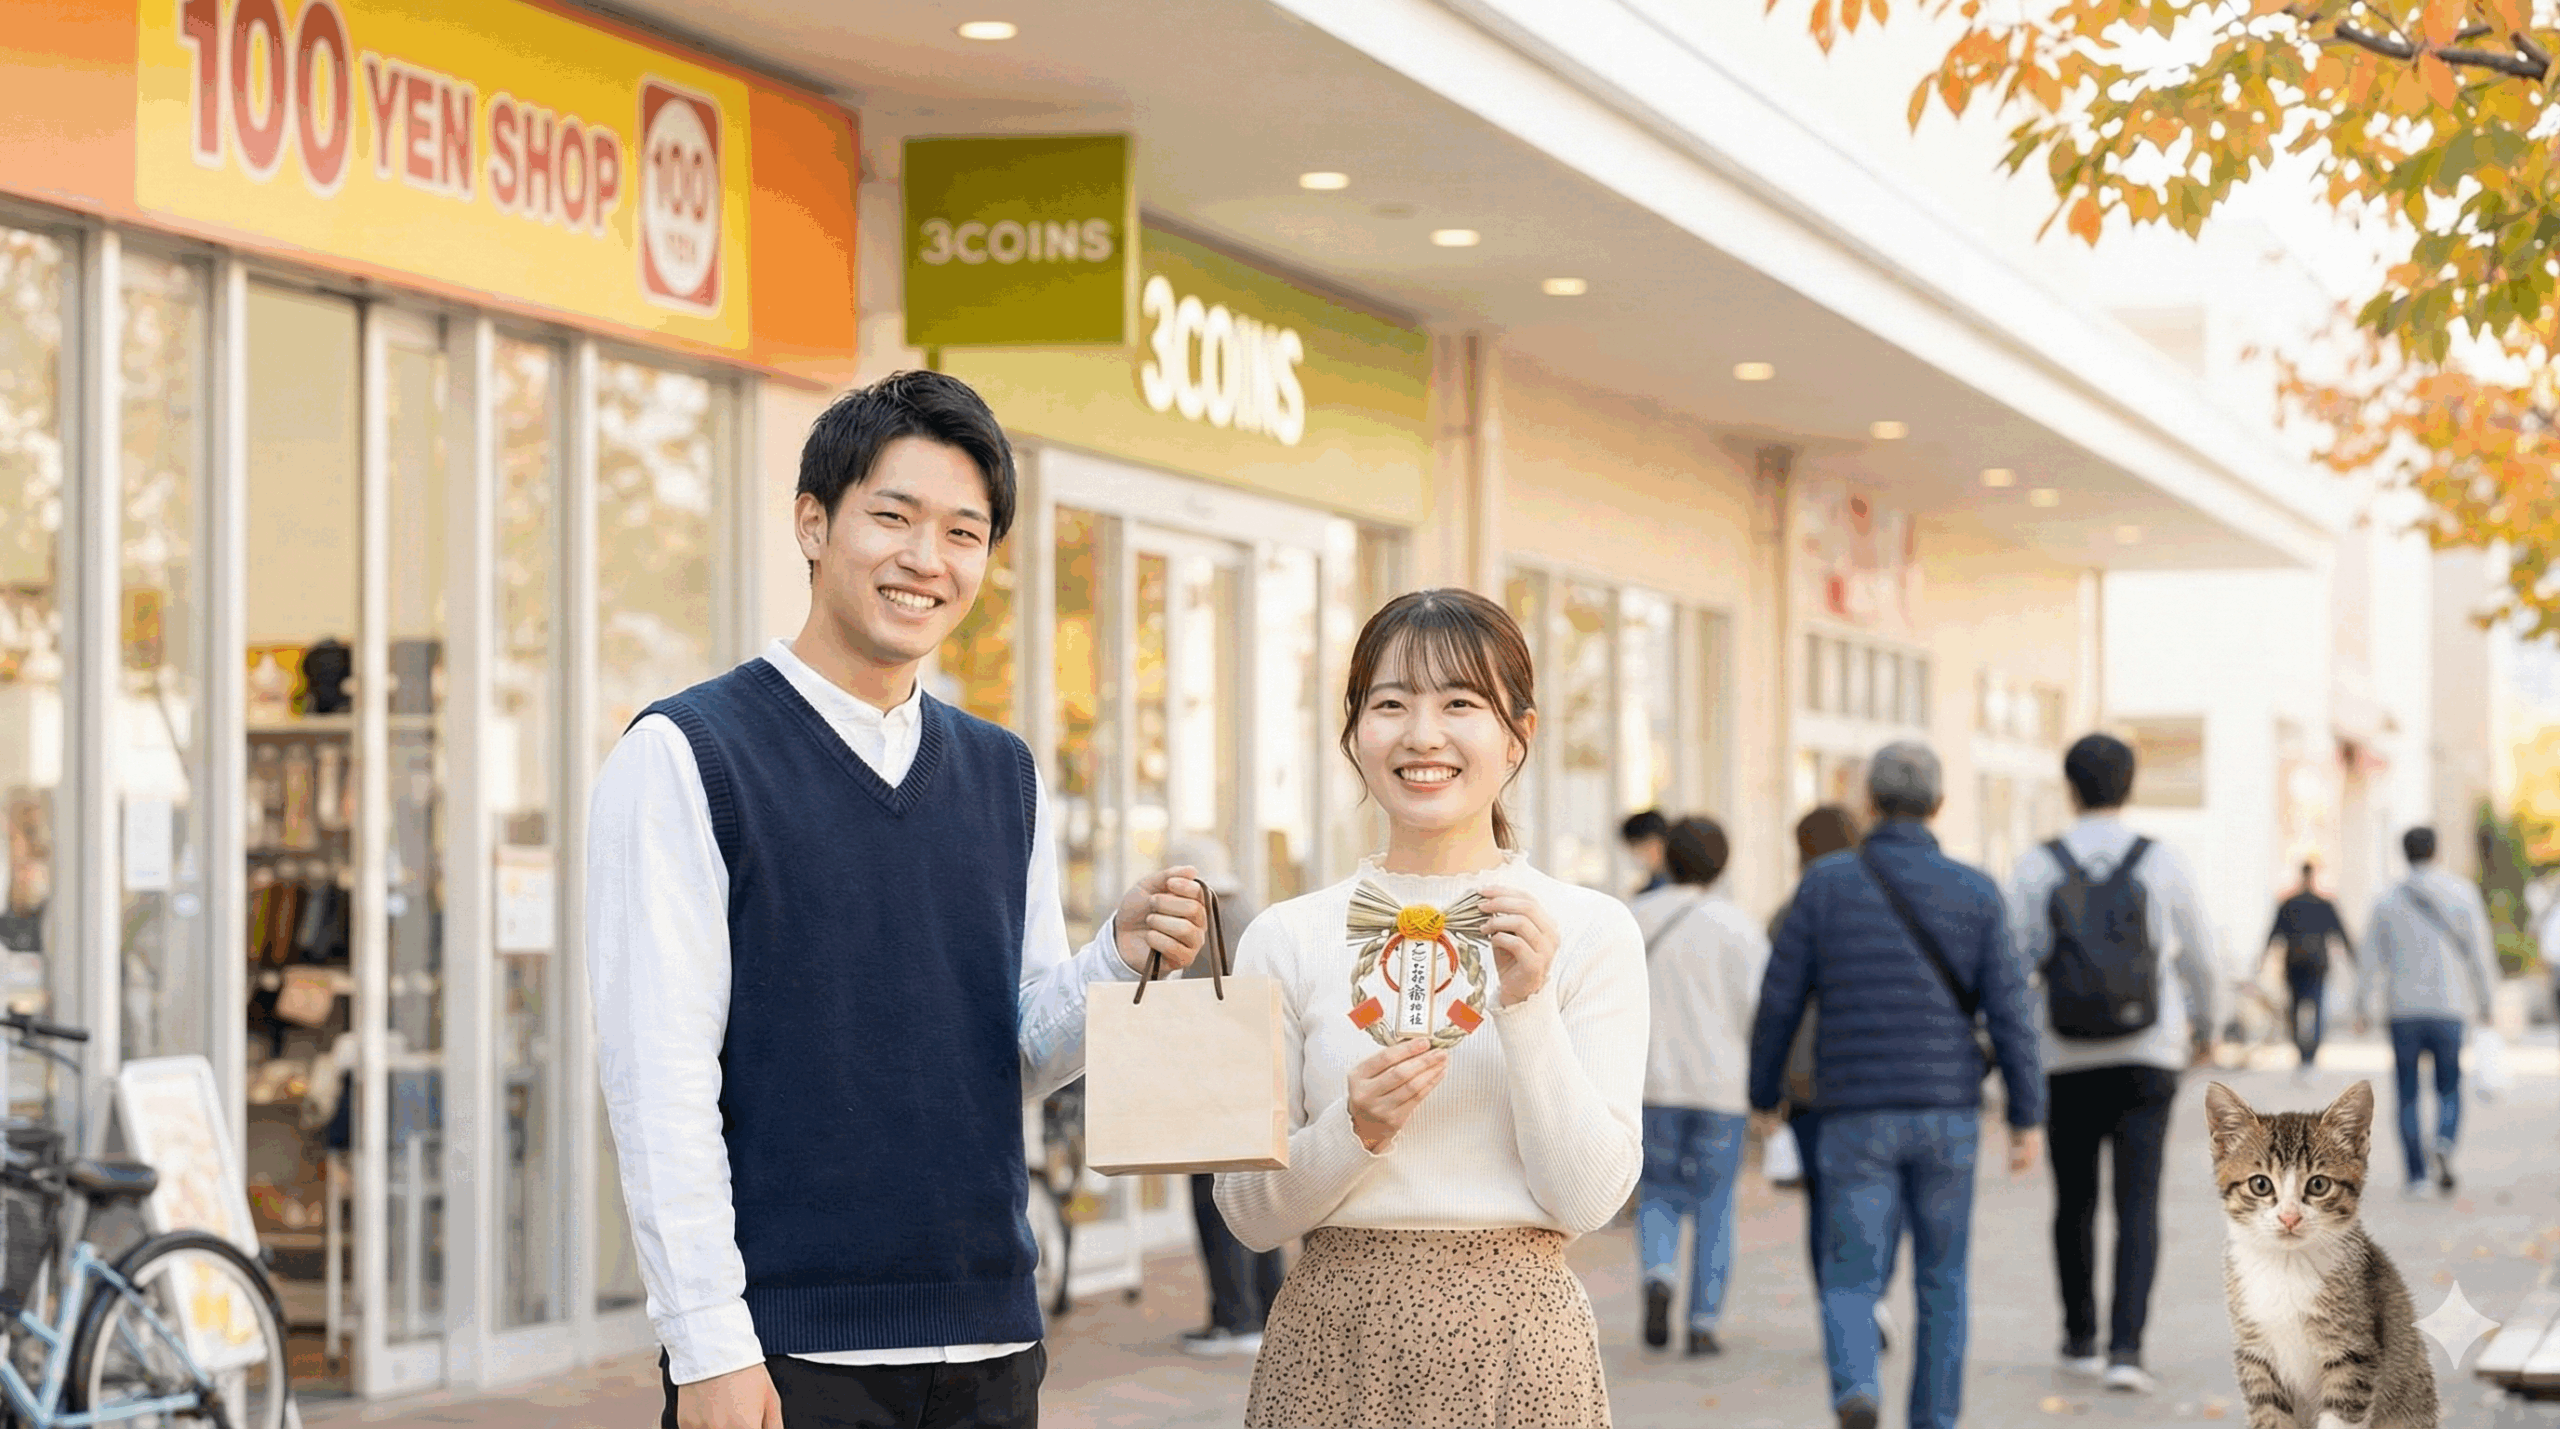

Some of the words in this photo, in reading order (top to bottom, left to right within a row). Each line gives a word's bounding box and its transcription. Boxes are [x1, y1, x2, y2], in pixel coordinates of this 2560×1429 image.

[182, 0, 350, 187] 100
[365, 59, 472, 192] YEN
[490, 100, 620, 229] SHOP
[652, 140, 710, 224] 100
[920, 218, 1114, 265] 3COINS
[1141, 275, 1304, 446] 3COINS
